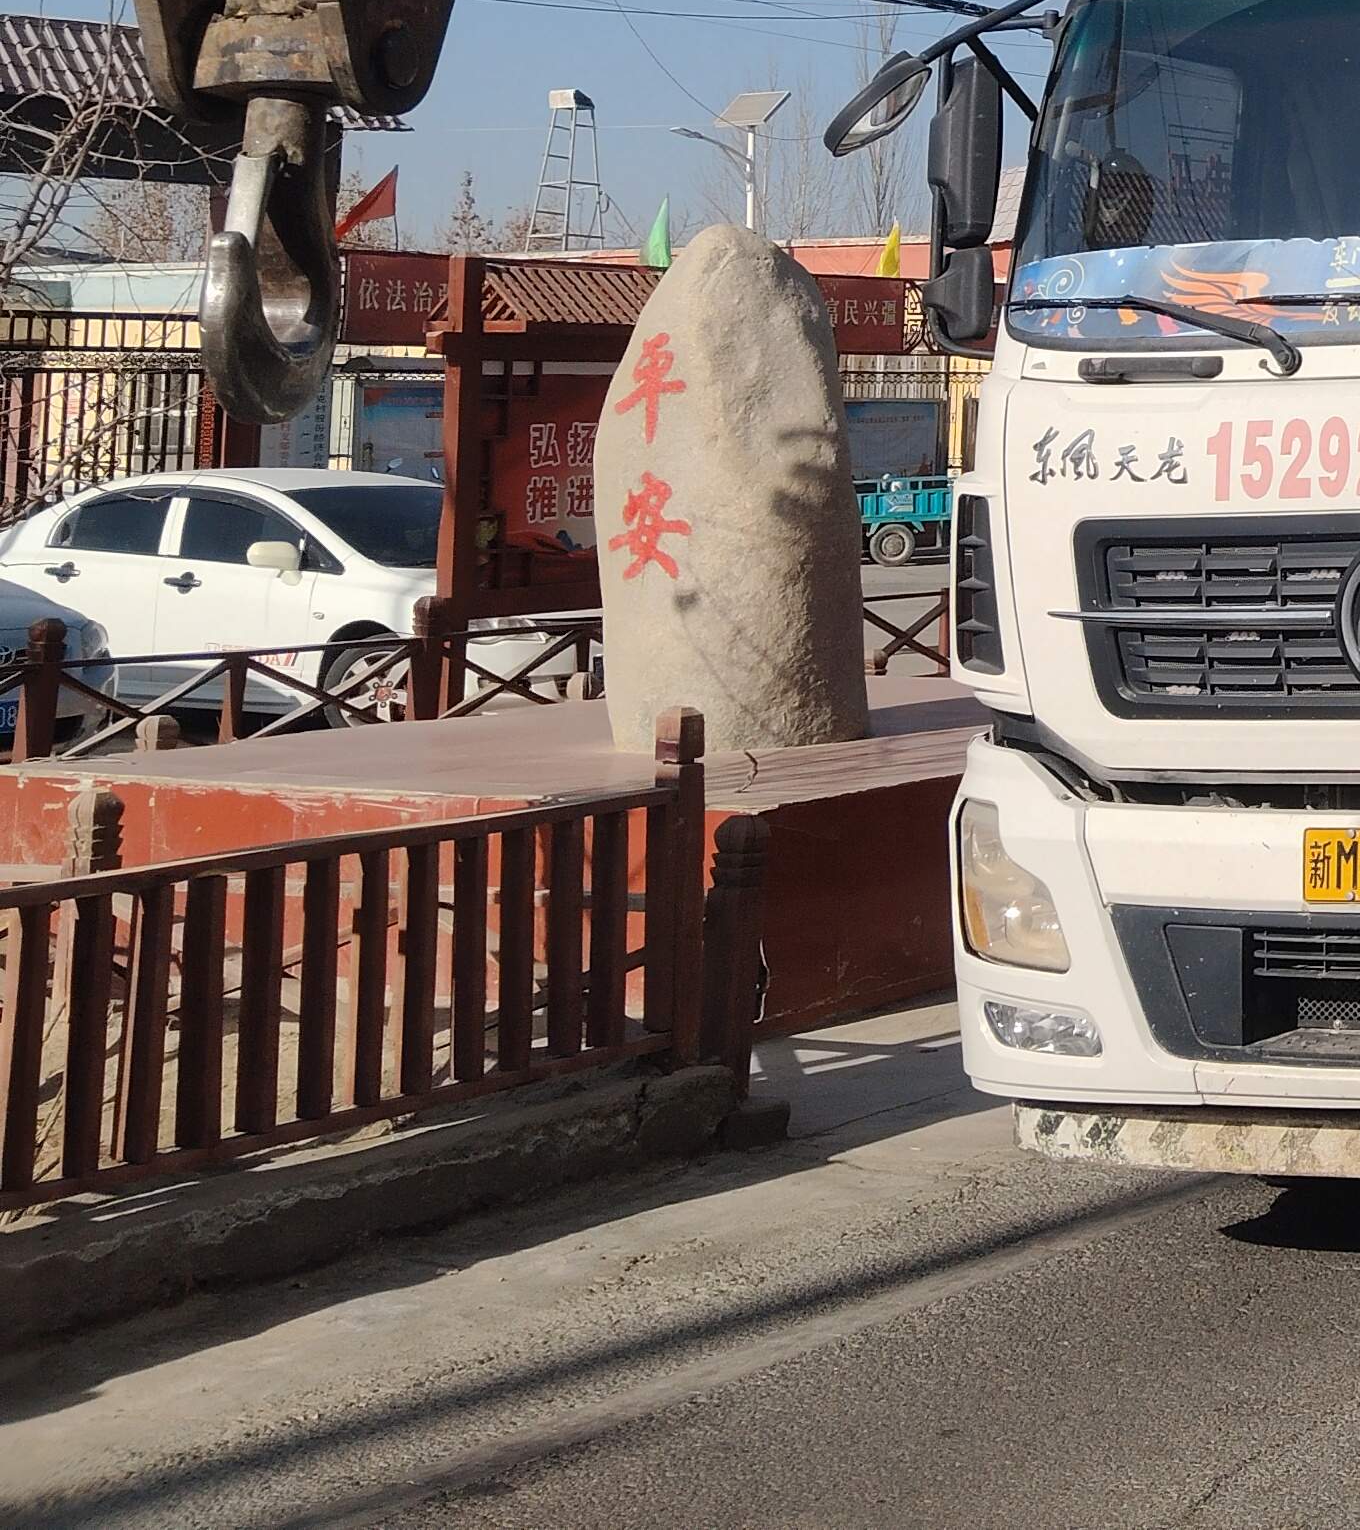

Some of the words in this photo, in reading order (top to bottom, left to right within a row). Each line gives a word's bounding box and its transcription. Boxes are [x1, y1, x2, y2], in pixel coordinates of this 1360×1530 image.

[529, 421, 598, 469] 弘扬
[608, 332, 692, 580] 平安
[526, 475, 595, 523] 推进
